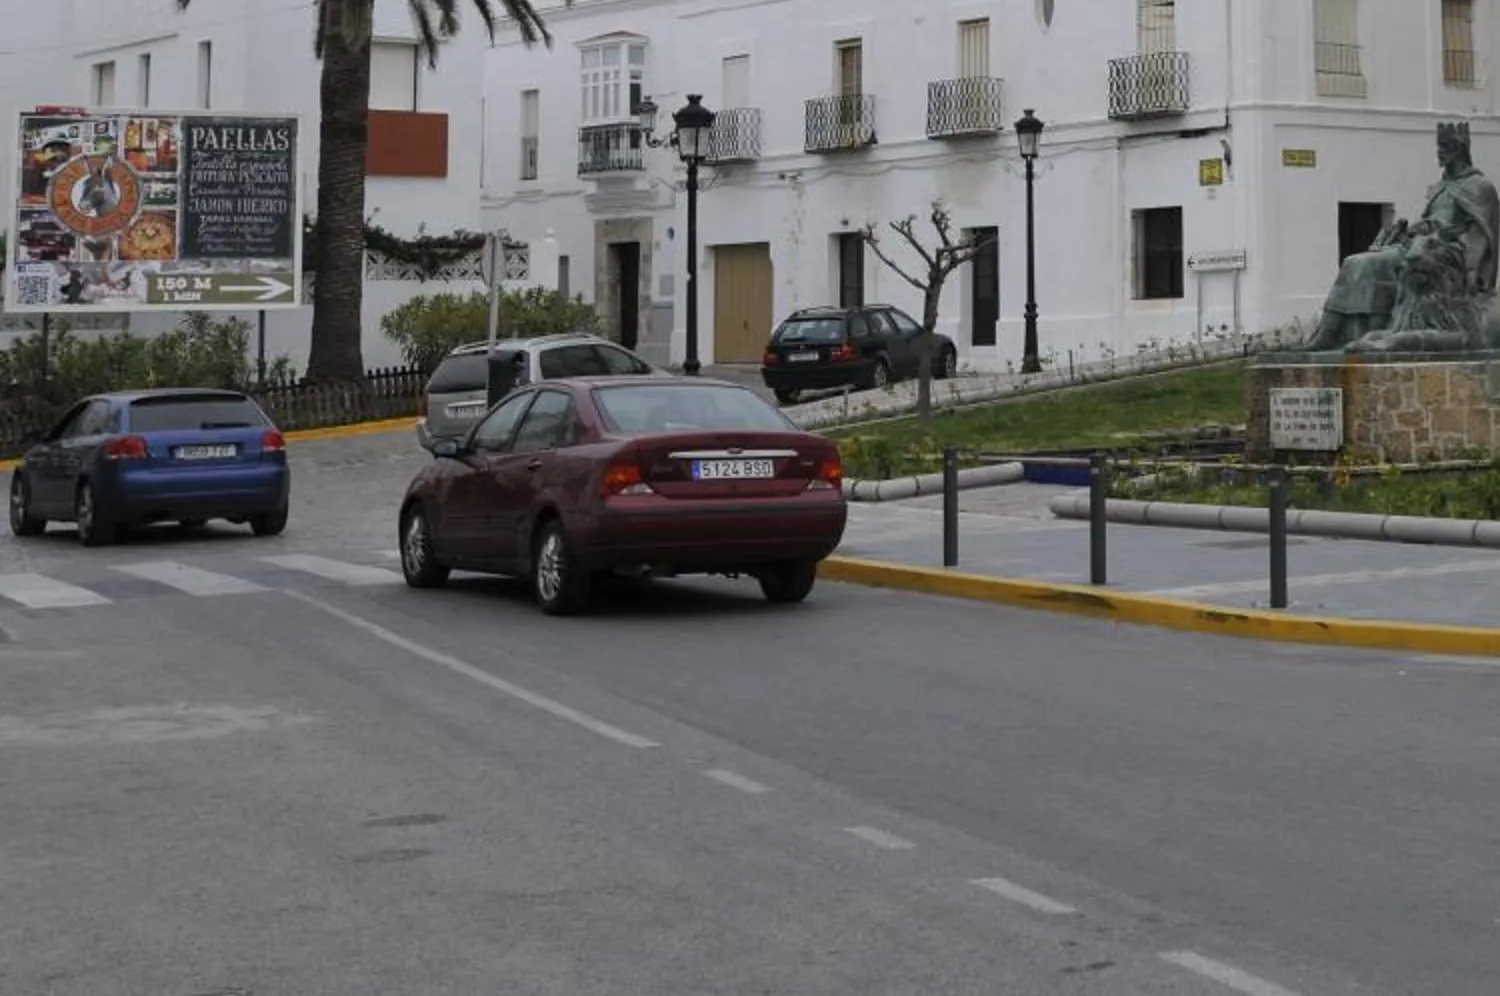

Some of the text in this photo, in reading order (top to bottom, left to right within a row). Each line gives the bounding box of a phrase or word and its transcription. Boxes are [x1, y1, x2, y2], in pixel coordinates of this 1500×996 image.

[191, 127, 289, 151] PAELLAS
[157, 276, 212, 290] 150 M
[702, 462, 740, 477] 5124
